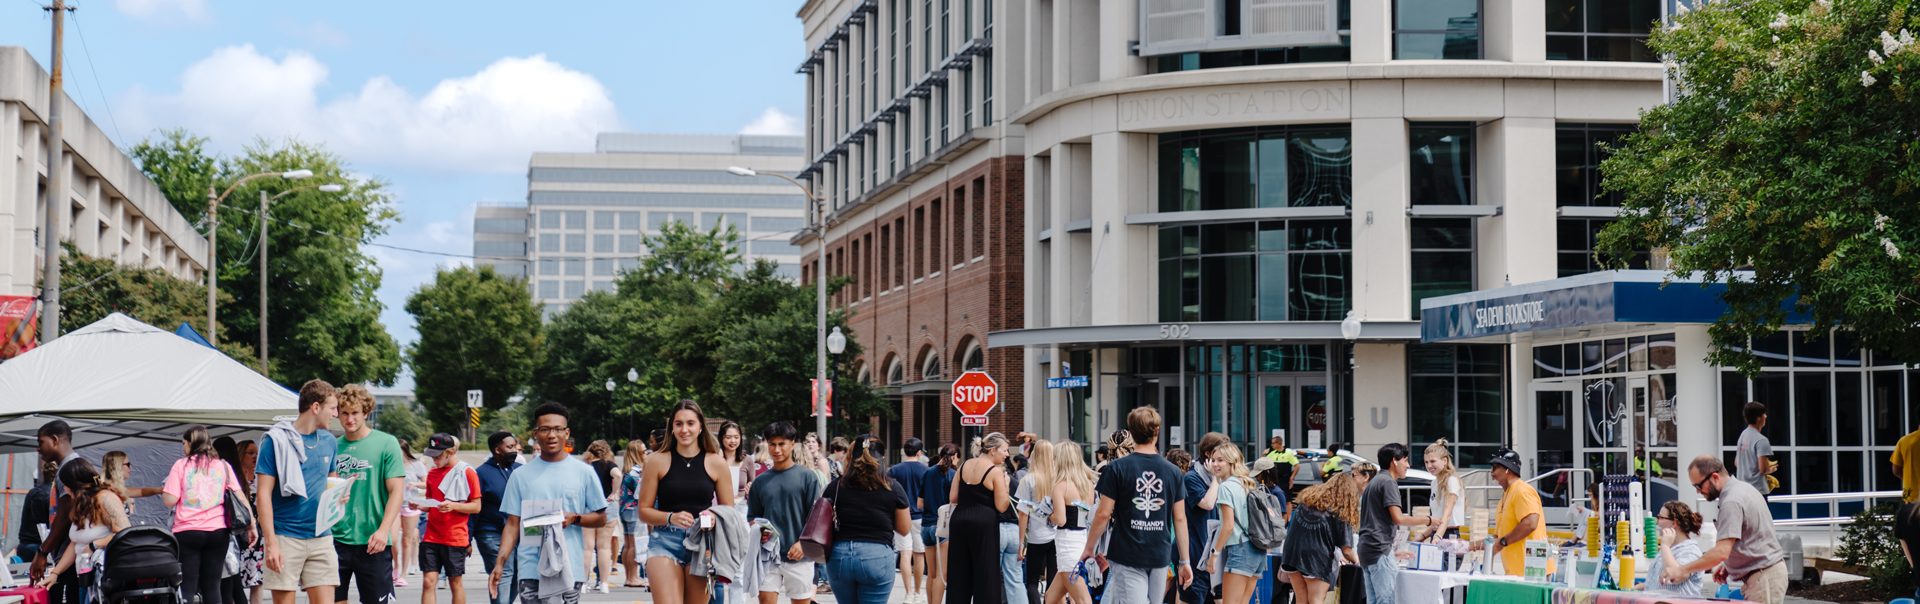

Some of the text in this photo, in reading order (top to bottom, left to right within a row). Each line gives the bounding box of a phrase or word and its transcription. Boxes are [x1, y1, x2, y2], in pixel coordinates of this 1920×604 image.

[1119, 87, 1345, 124] UNION STATION
[1476, 300, 1544, 328] SEA DEVIL BOOKSTORE
[1160, 324, 1190, 339] 502
[955, 385, 995, 403] STOP
[1370, 407, 1389, 430] U
[1131, 519, 1164, 527] PORTLAND'S
